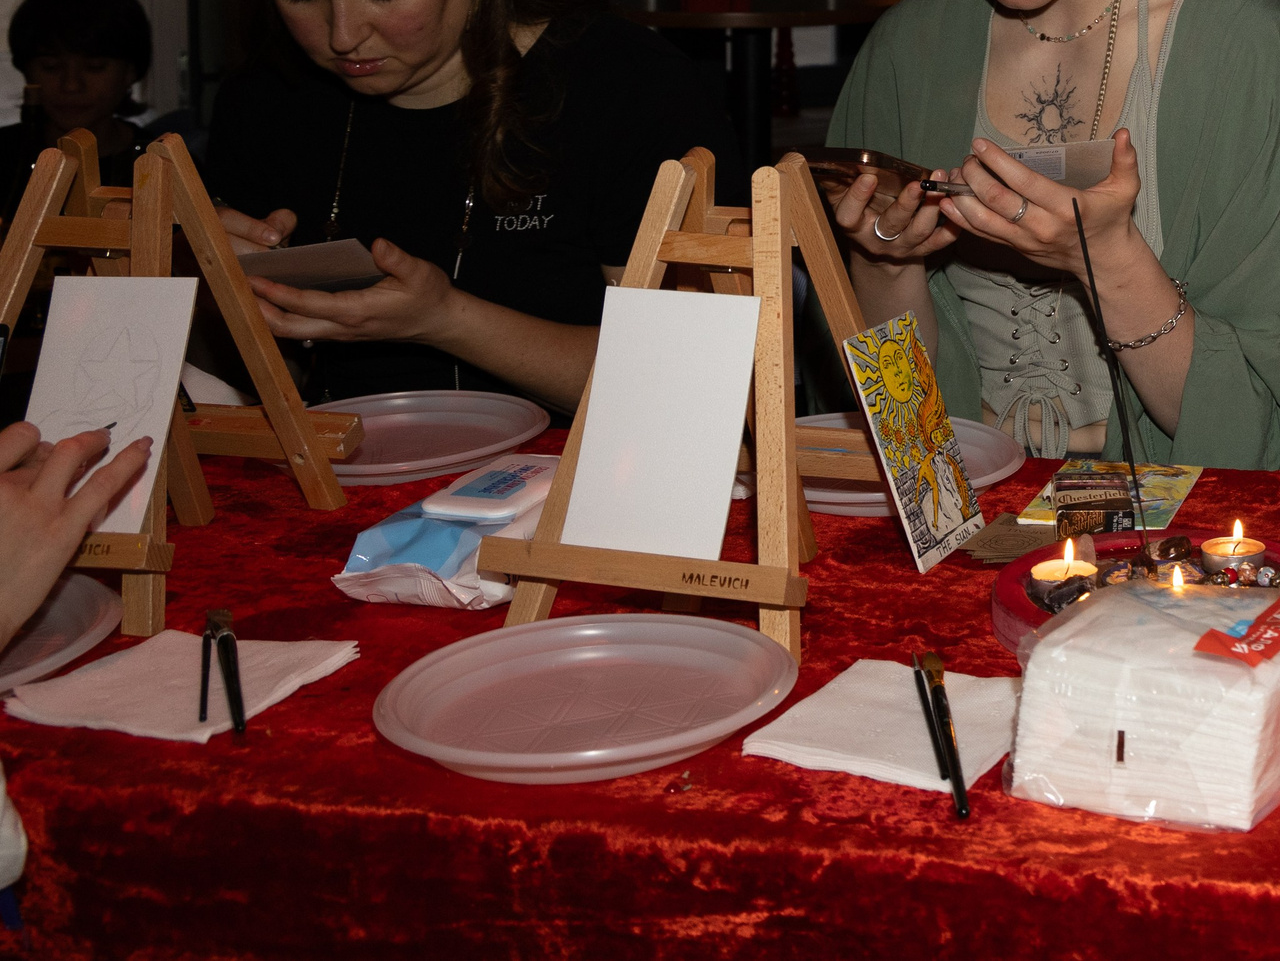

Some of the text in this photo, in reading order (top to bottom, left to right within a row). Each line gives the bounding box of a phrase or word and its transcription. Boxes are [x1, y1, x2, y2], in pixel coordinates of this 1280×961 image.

[495, 214, 554, 231] TODAY
[1058, 490, 1129, 504] Chesterfield
[1060, 509, 1104, 538] Chesterfield
[80, 544, 111, 556] VICH
[936, 527, 974, 557] THE SUN.
[681, 572, 750, 590] MALEVICH
